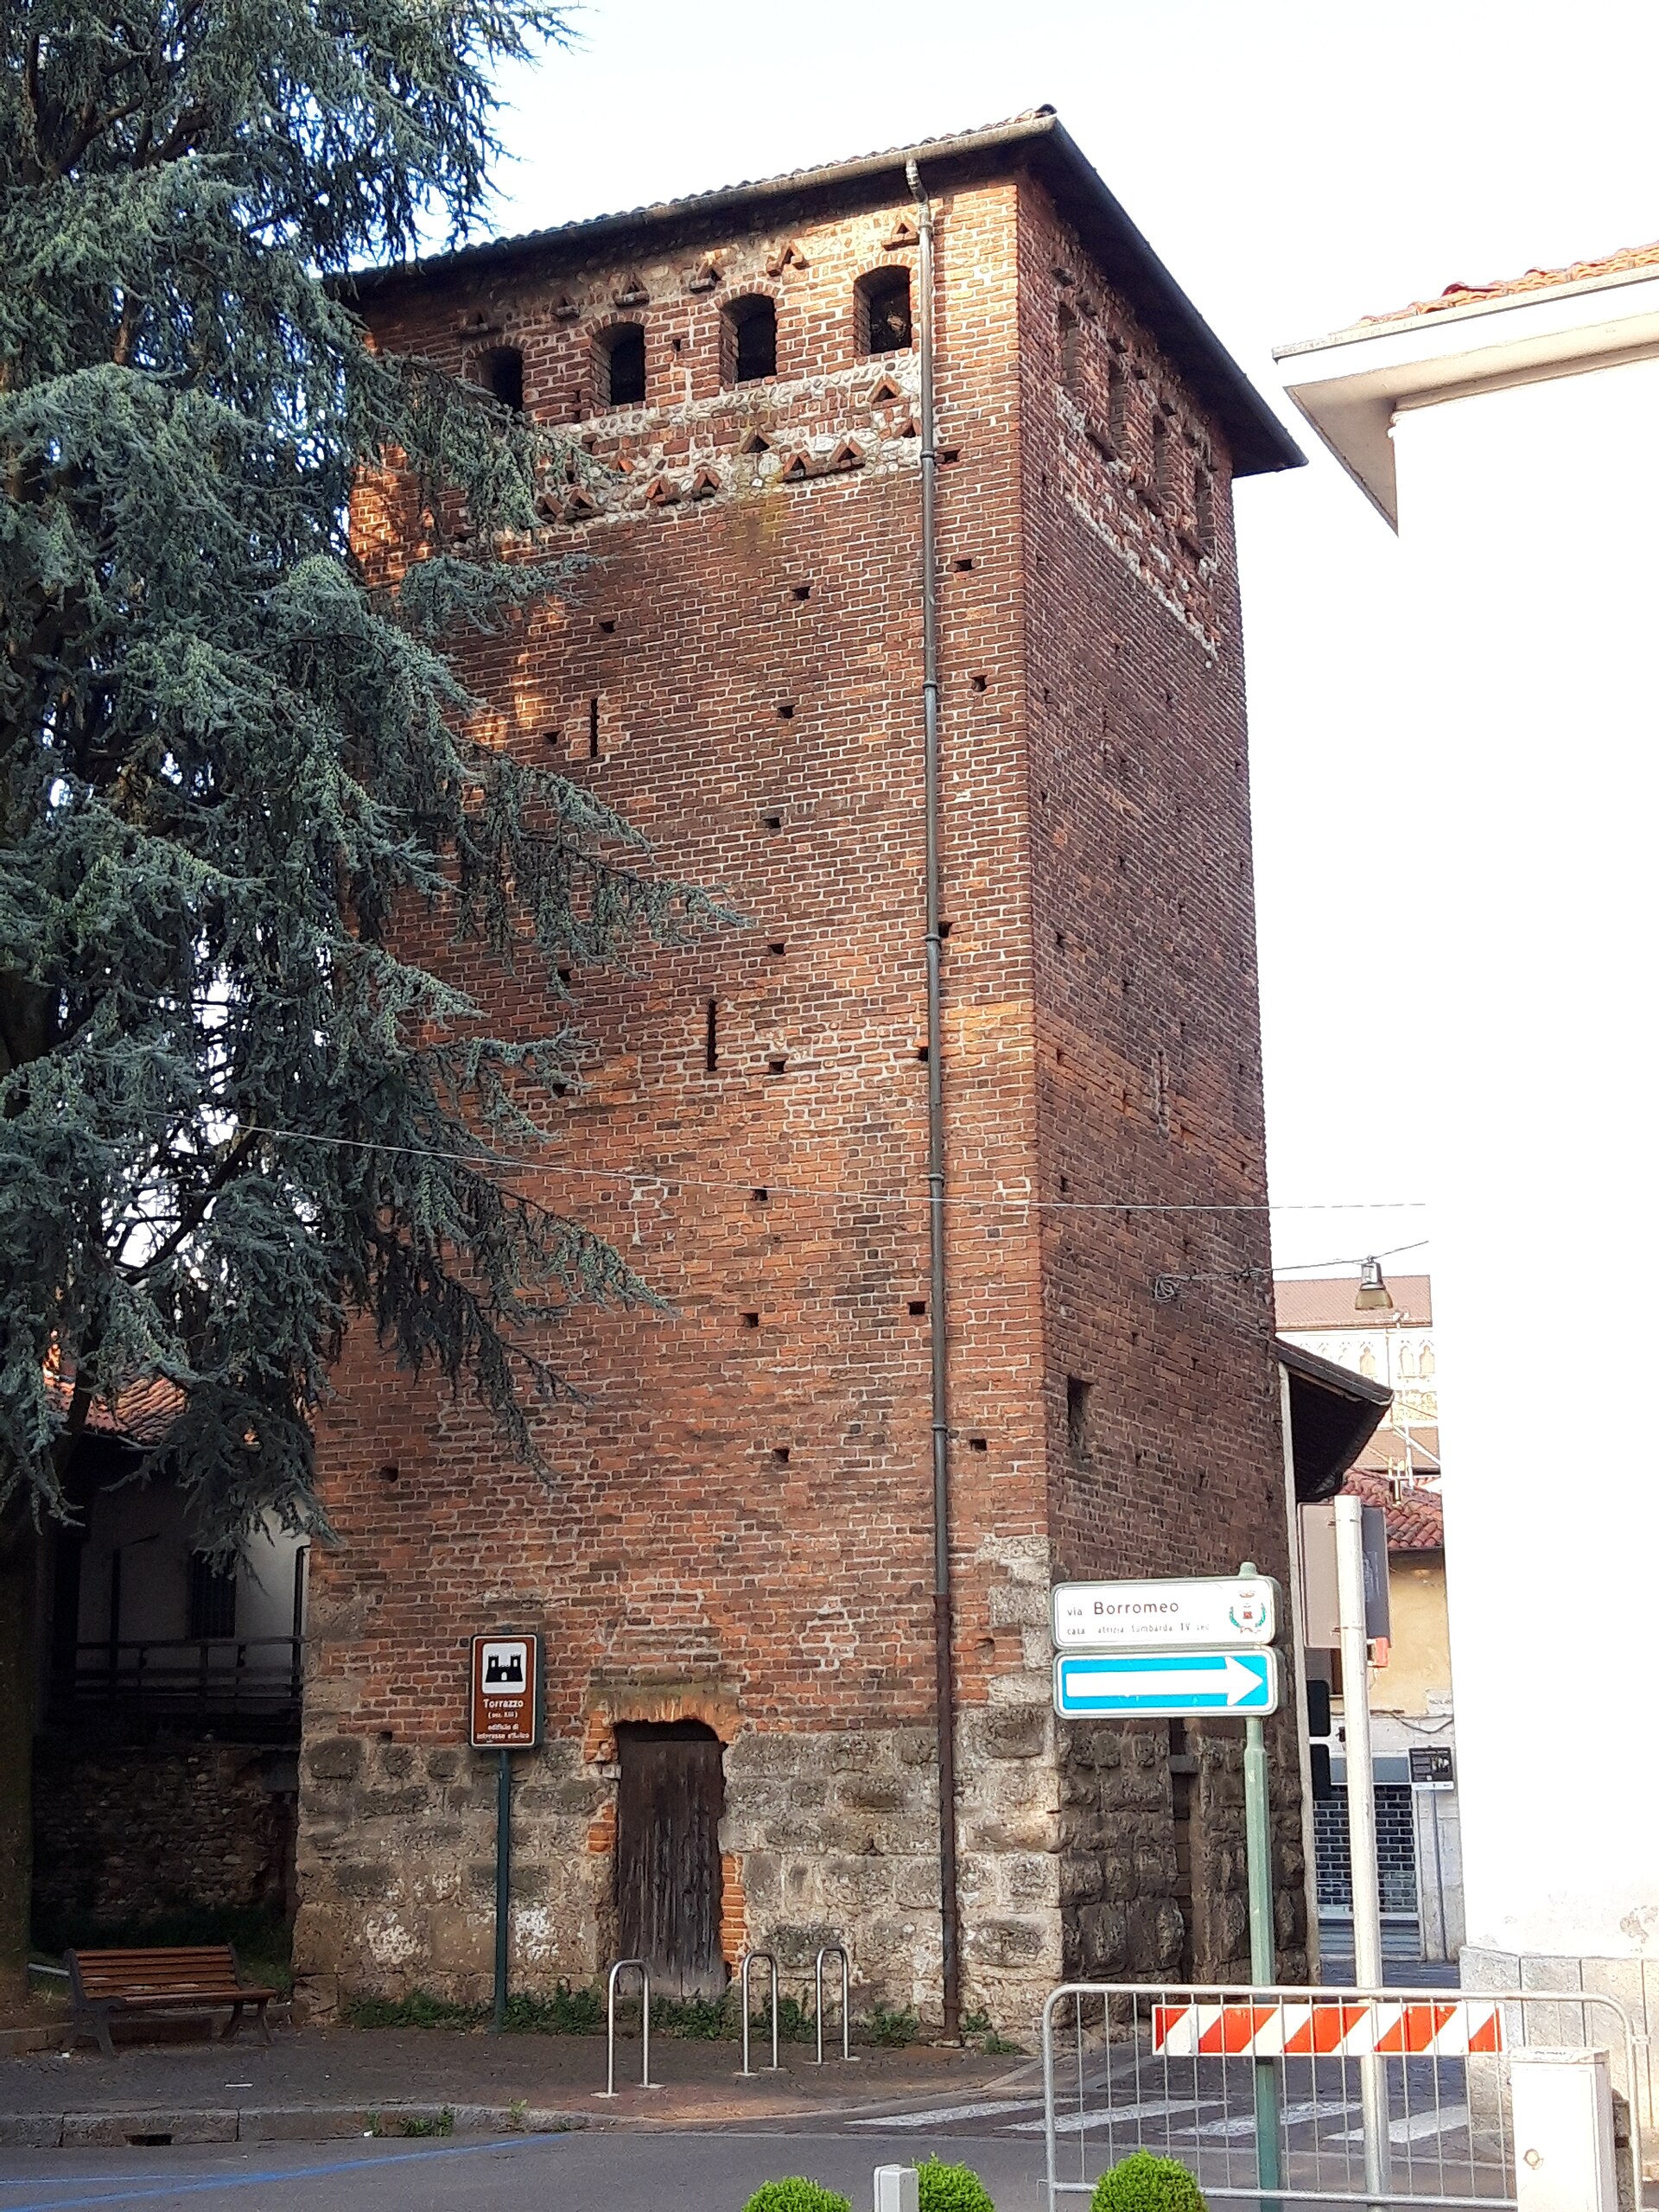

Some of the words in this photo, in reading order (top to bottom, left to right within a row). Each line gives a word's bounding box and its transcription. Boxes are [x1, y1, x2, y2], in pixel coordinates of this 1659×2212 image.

[1067, 1606, 1083, 1617] via
[1094, 1601, 1179, 1616] Borromeo
[1094, 1625, 1124, 1634] atrizia
[483, 1698, 524, 1708] Torrazzo
